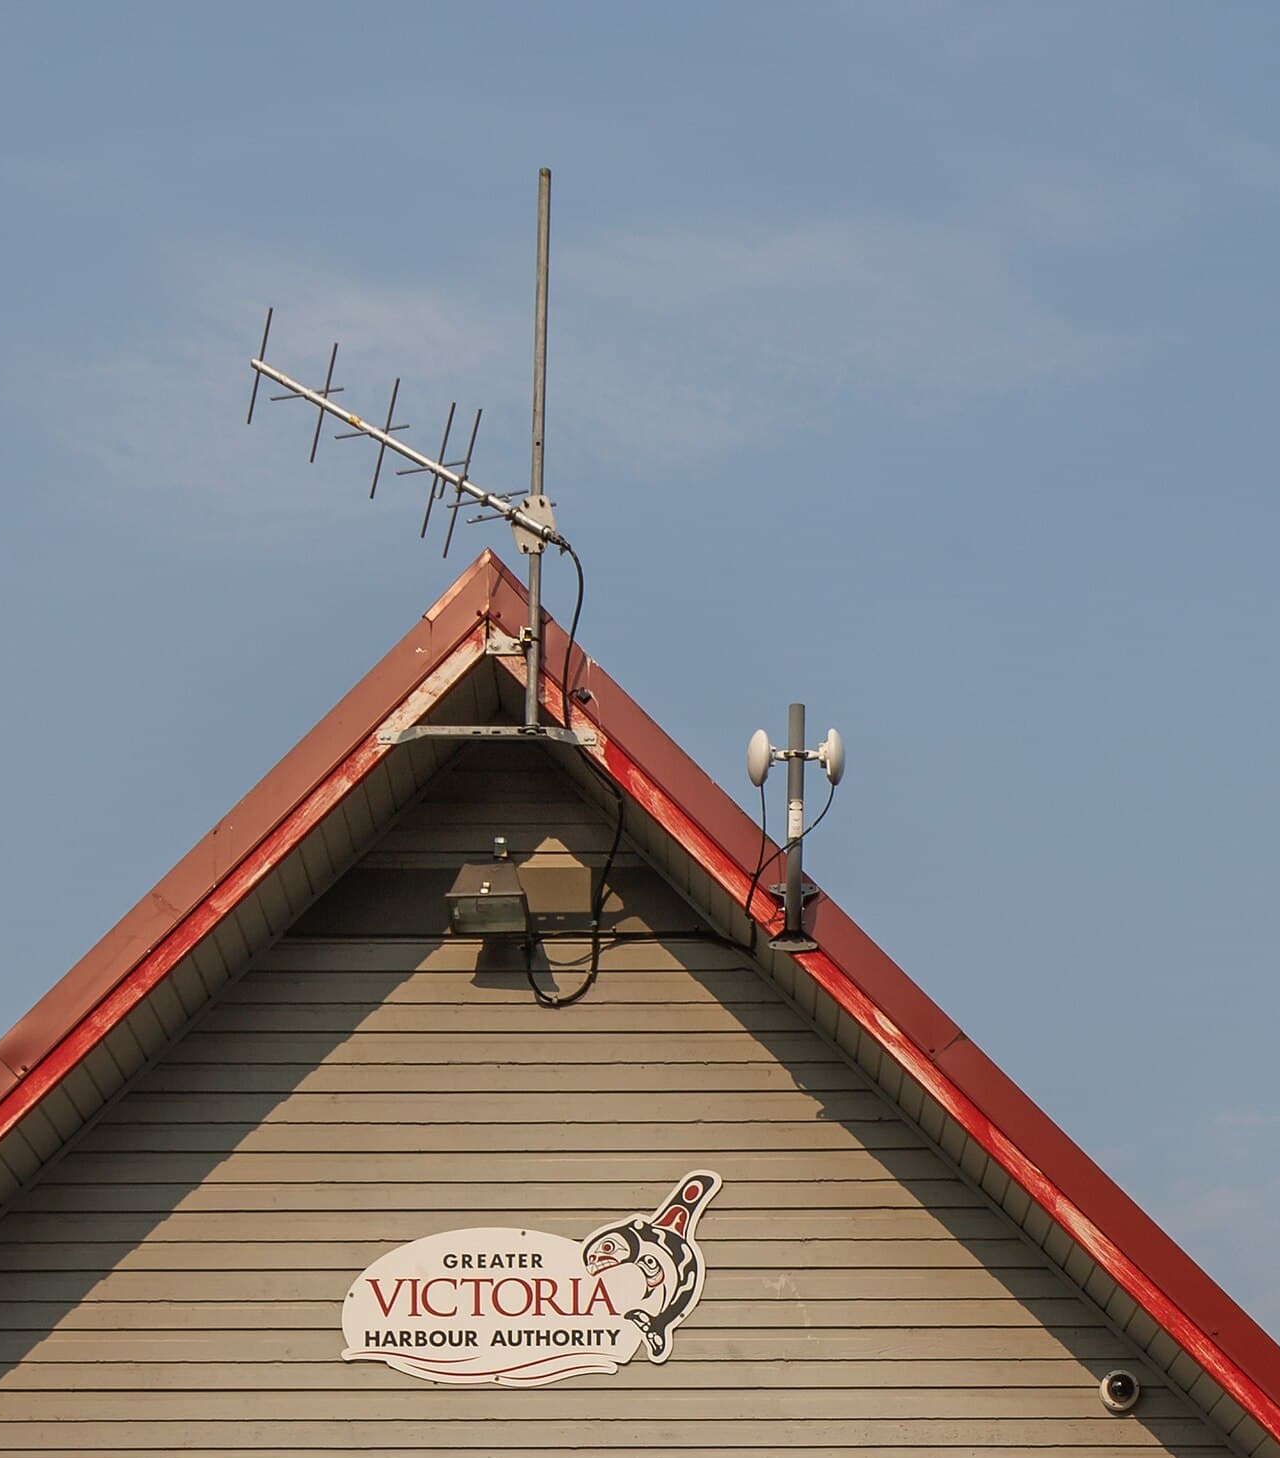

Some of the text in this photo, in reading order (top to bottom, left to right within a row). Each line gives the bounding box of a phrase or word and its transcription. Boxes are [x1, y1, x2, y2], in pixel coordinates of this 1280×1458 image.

[442, 1254, 543, 1269] GREATER
[365, 1276, 621, 1318] VICTORIA
[365, 1328, 621, 1347] HARBOUR AUTHORITY
